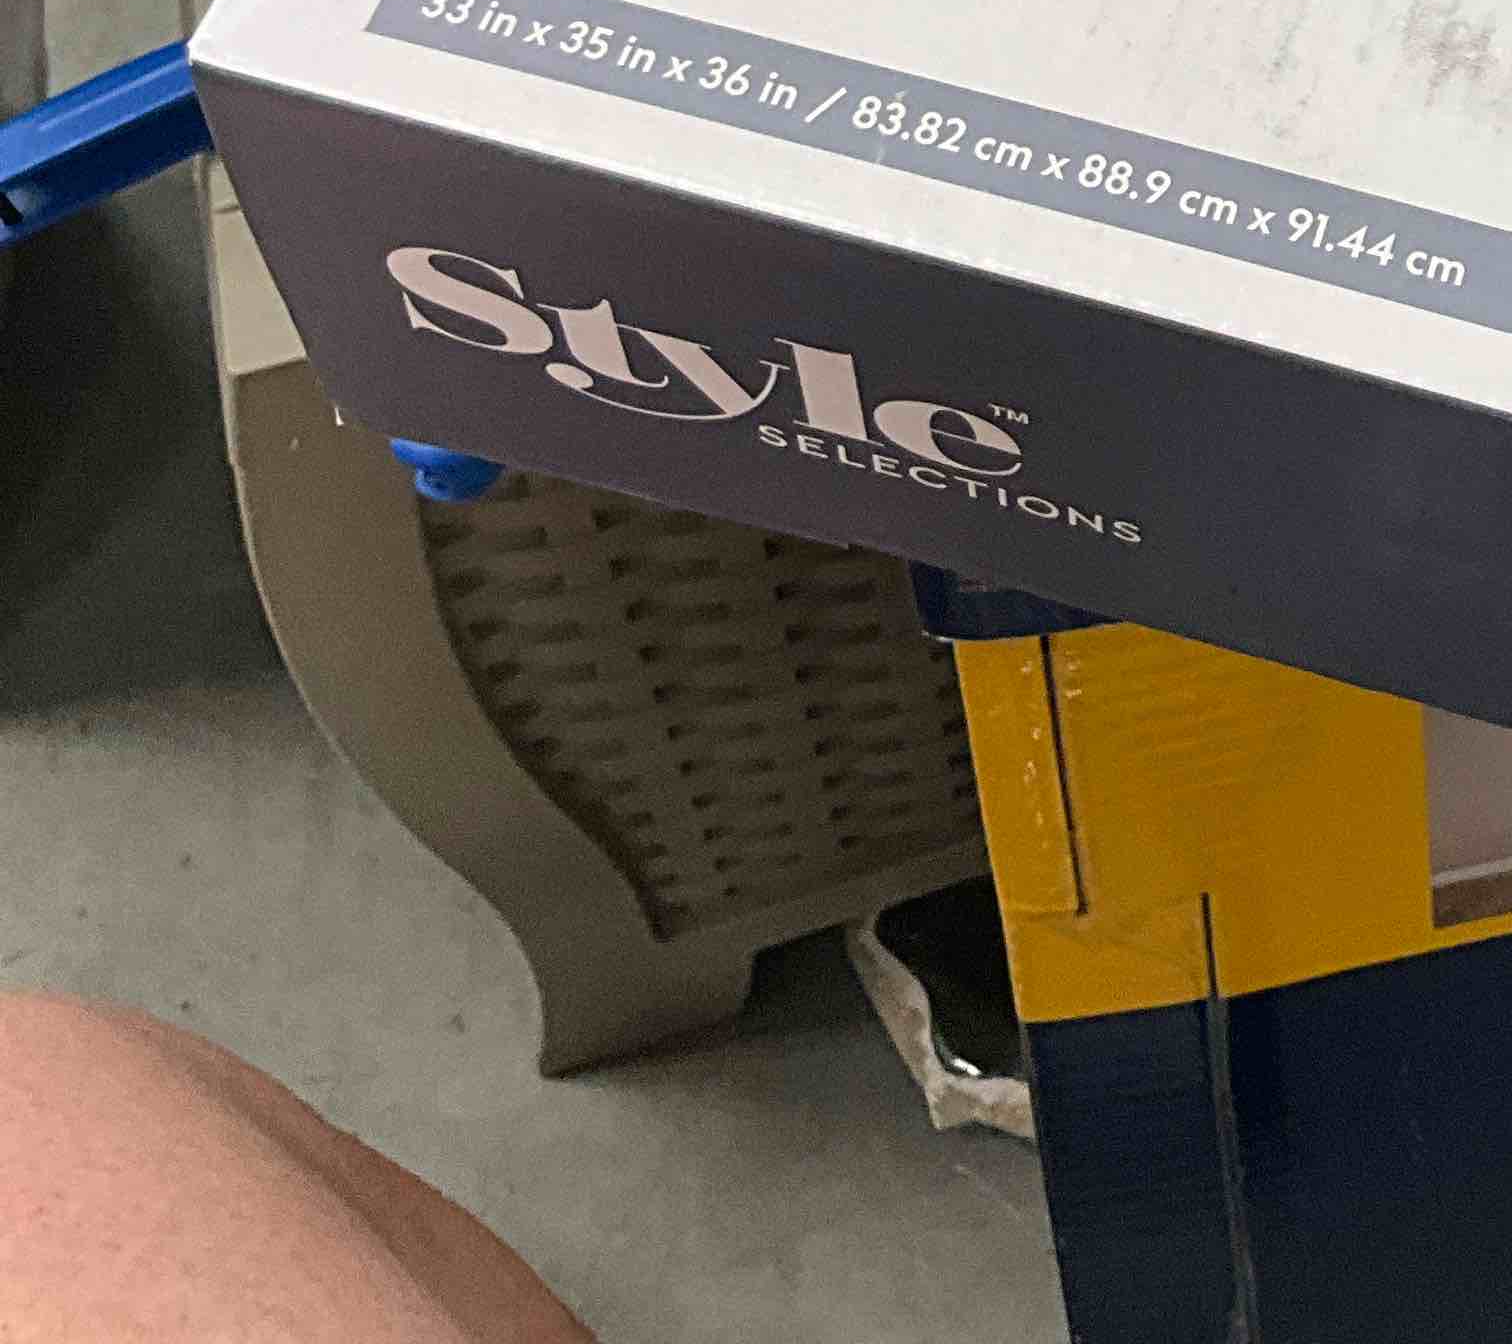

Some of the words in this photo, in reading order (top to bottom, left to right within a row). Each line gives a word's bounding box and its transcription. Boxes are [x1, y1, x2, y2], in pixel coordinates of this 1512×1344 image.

[477, 0, 518, 37] in
[559, 21, 615, 60] 35
[616, 35, 656, 73] in
[698, 56, 752, 96] 36
[758, 71, 798, 110] in
[852, 95, 967, 153] 83.82
[973, 137, 1033, 171] cm
[1078, 153, 1172, 204] 88.9
[1178, 190, 1238, 225] cm
[1288, 207, 1396, 267] 91.44
[1405, 251, 1466, 287] cm
[385, 246, 1024, 476] Style
[758, 423, 1143, 546] SELECTIONS
